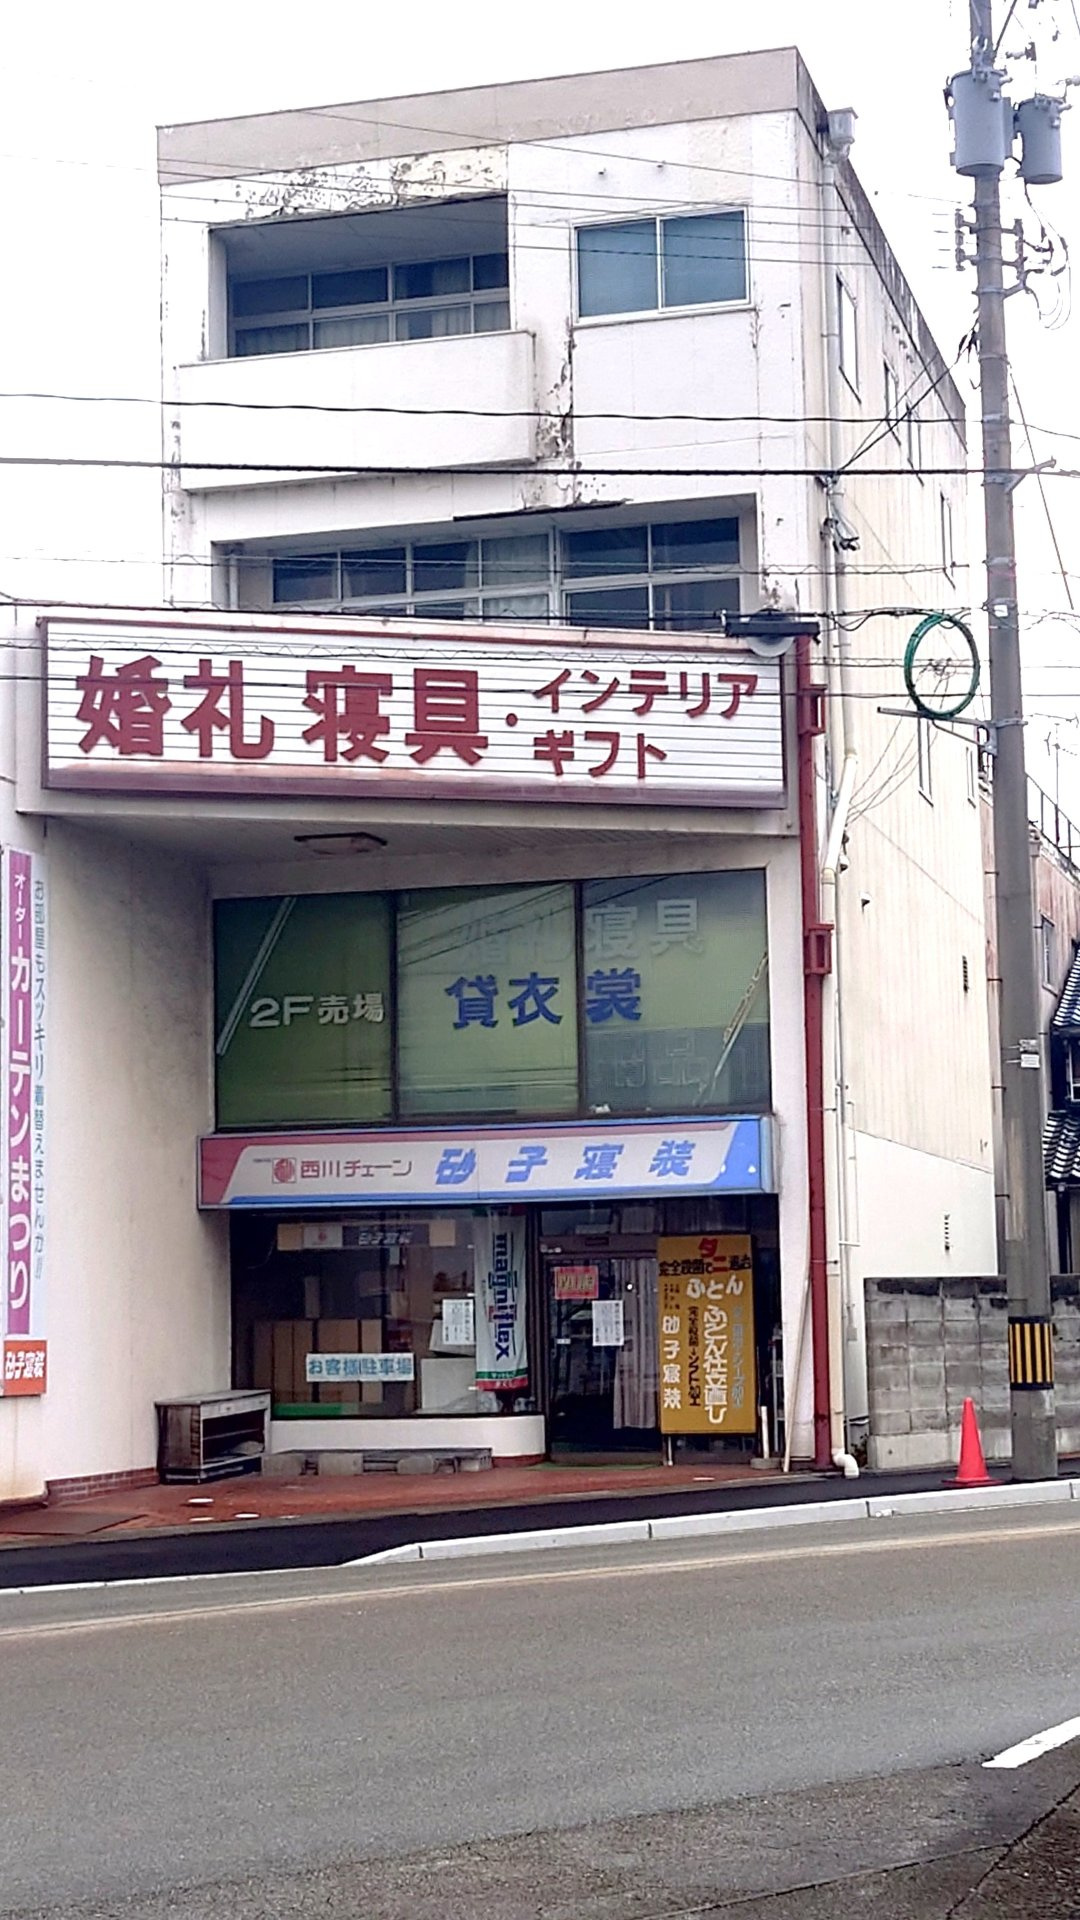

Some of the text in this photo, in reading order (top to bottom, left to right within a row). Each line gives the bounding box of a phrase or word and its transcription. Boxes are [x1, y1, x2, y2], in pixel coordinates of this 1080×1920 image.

[532, 668, 758, 719] インテリア
[534, 730, 667, 779] ギフト
[444, 966, 642, 1030] 貸衣裳
[301, 1159, 412, 1179] 西川チェーン
[435, 1139, 696, 1185] 砂子寝装
[493, 1232, 514, 1361] magniflex
[687, 1274, 743, 1300] ふとん
[308, 1357, 413, 1376] お客様駐車場
